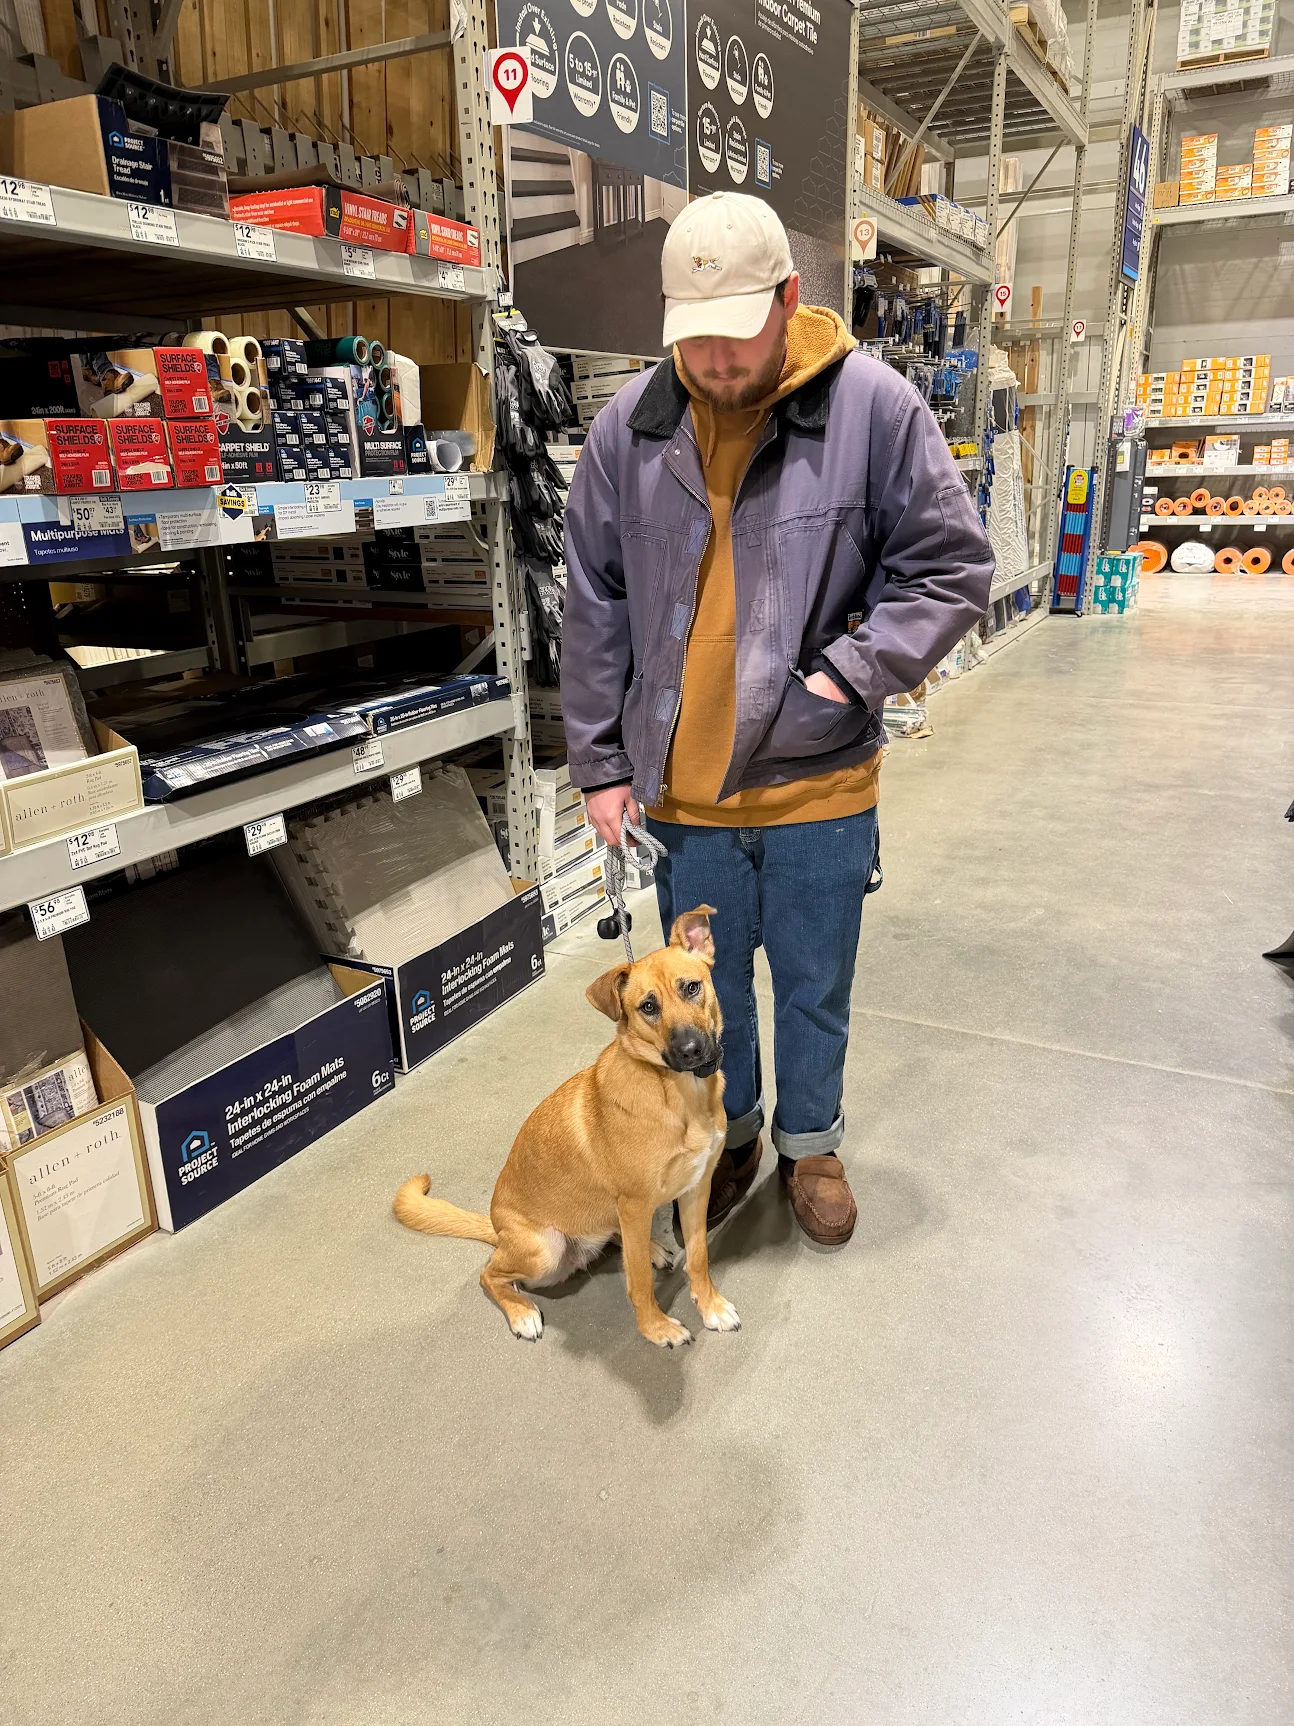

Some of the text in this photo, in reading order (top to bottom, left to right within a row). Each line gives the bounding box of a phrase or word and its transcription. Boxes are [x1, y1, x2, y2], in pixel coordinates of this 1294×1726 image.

[515, 3, 558, 50] Install Over Existing
[652, 20, 662, 33] Stain
[782, 4, 806, 36] Carpet
[806, 21, 818, 44] Tile
[535, 54, 554, 72] Surface
[569, 53, 574, 68] 5
[575, 57, 584, 73] to
[504, 68, 517, 81] 11
[531, 74, 550, 90] looring
[576, 74, 592, 89] Limited
[612, 90, 625, 106] Family
[616, 110, 632, 126] Friendly
[112, 156, 153, 170] Drainage Stair
[113, 166, 131, 174] Tread
[1133, 136, 1147, 194] 46
[859, 229, 870, 237] 13
[160, 354, 196, 363] SURFACE
[162, 364, 196, 373] SHIELDS
[55, 425, 98, 435] SURFACE
[115, 425, 155, 434] SURFACE
[174, 425, 209, 434] SURFACE
[56, 435, 96, 446] SHIELDS
[118, 435, 153, 444] SHIELDS
[176, 434, 208, 444] SHIELDS
[364, 442, 402, 450] MULTI SURFACE
[219, 443, 269, 452] ARPET SHIELD
[220, 498, 245, 507] SAVINGS
[31, 530, 98, 541] Multipurpose
[389, 549, 409, 560] Style
[390, 571, 410, 580] Style
[0, 689, 45, 702] llen roth
[15, 804, 48, 822] allen
[60, 792, 85, 808] roth
[441, 966, 460, 984] 24-in
[465, 952, 483, 968] 24-in
[442, 941, 514, 995] Interlocking Foam Mats
[443, 990, 461, 1007] Tapetes
[410, 1005, 436, 1026] PROJECT
[411, 1013, 436, 1033] SOURCE
[225, 1074, 292, 1120] 24-in x 24-in
[227, 1057, 345, 1135] Interlocking Foam Mats
[92, 1108, 124, 1126] #5232188
[230, 1070, 347, 1148] Tapetes de espuma con empalme
[231, 1148, 244, 1158] IDEAL
[252, 1135, 263, 1147] HOME
[283, 1107, 309, 1126] WORKSPACES
[29, 1157, 70, 1185] allen
[86, 1130, 119, 1154] roth
[178, 1147, 218, 1177] PROJECT
[181, 1157, 219, 1185] SOURCE
